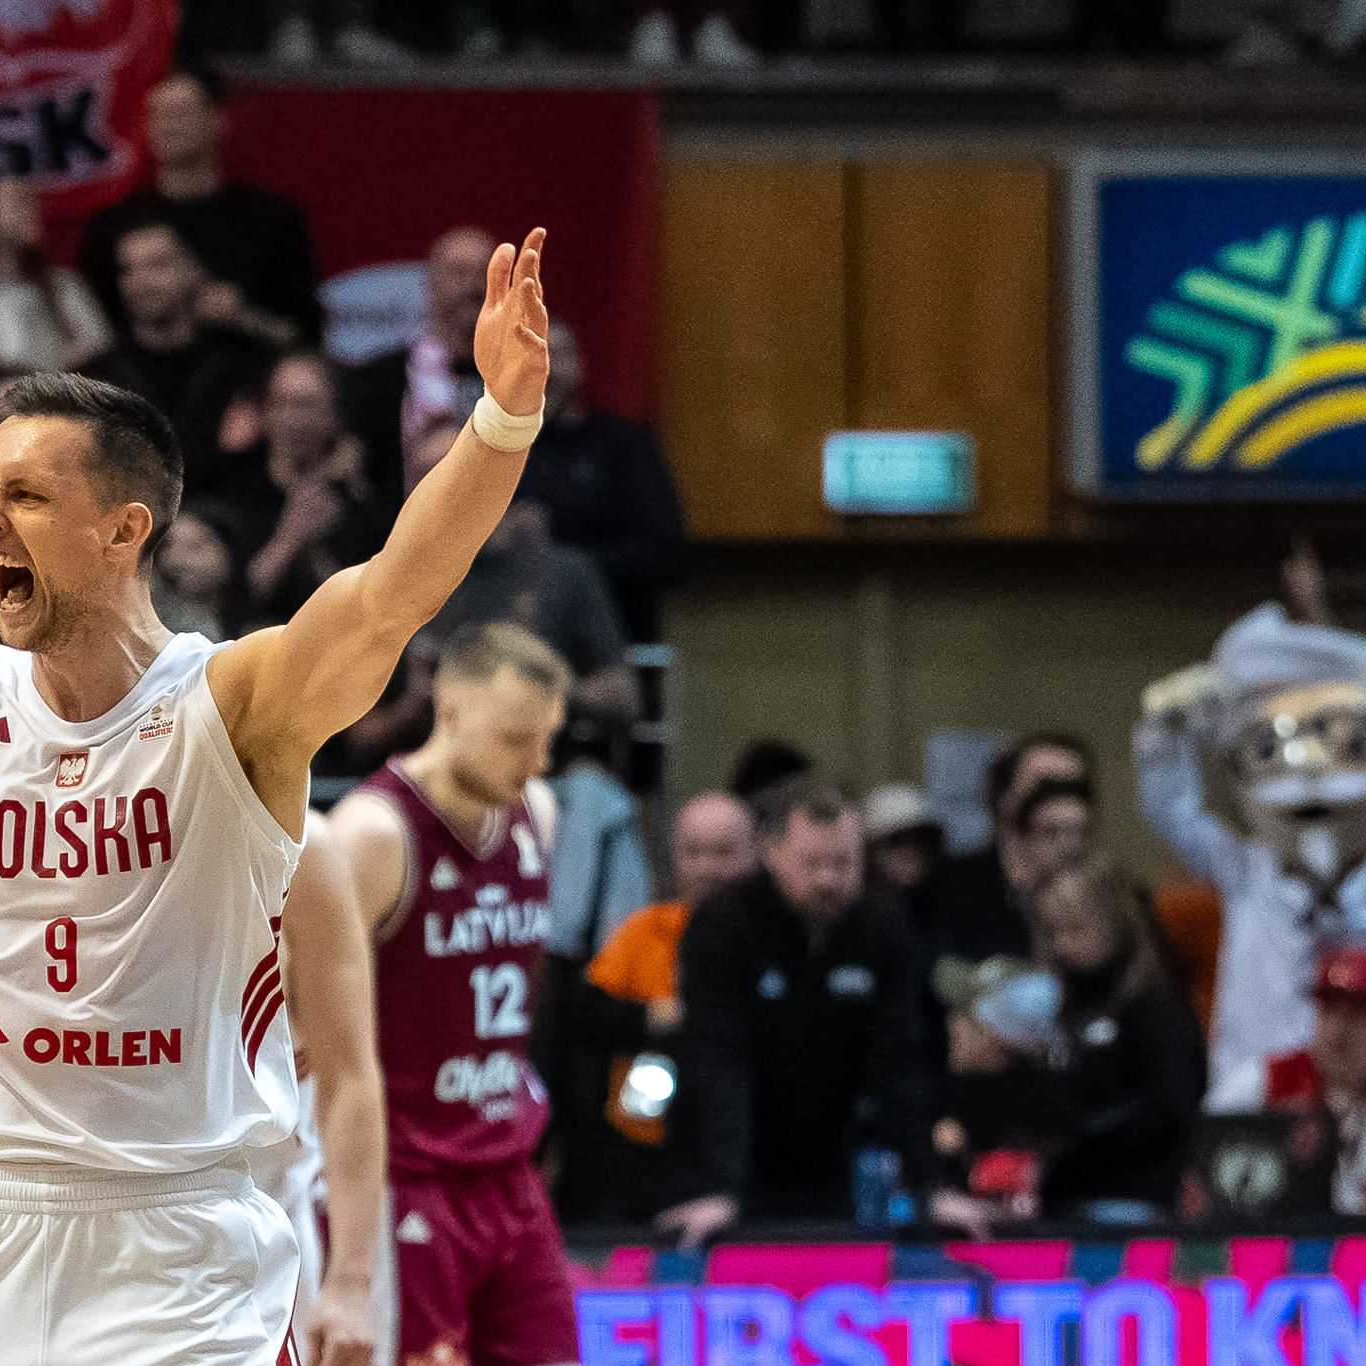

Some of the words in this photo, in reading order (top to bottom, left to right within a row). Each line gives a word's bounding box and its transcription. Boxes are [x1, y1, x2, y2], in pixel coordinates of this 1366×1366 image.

[45, 917, 78, 993] 9
[469, 961, 531, 1040] 12
[22, 1027, 182, 1067] ORLEN
